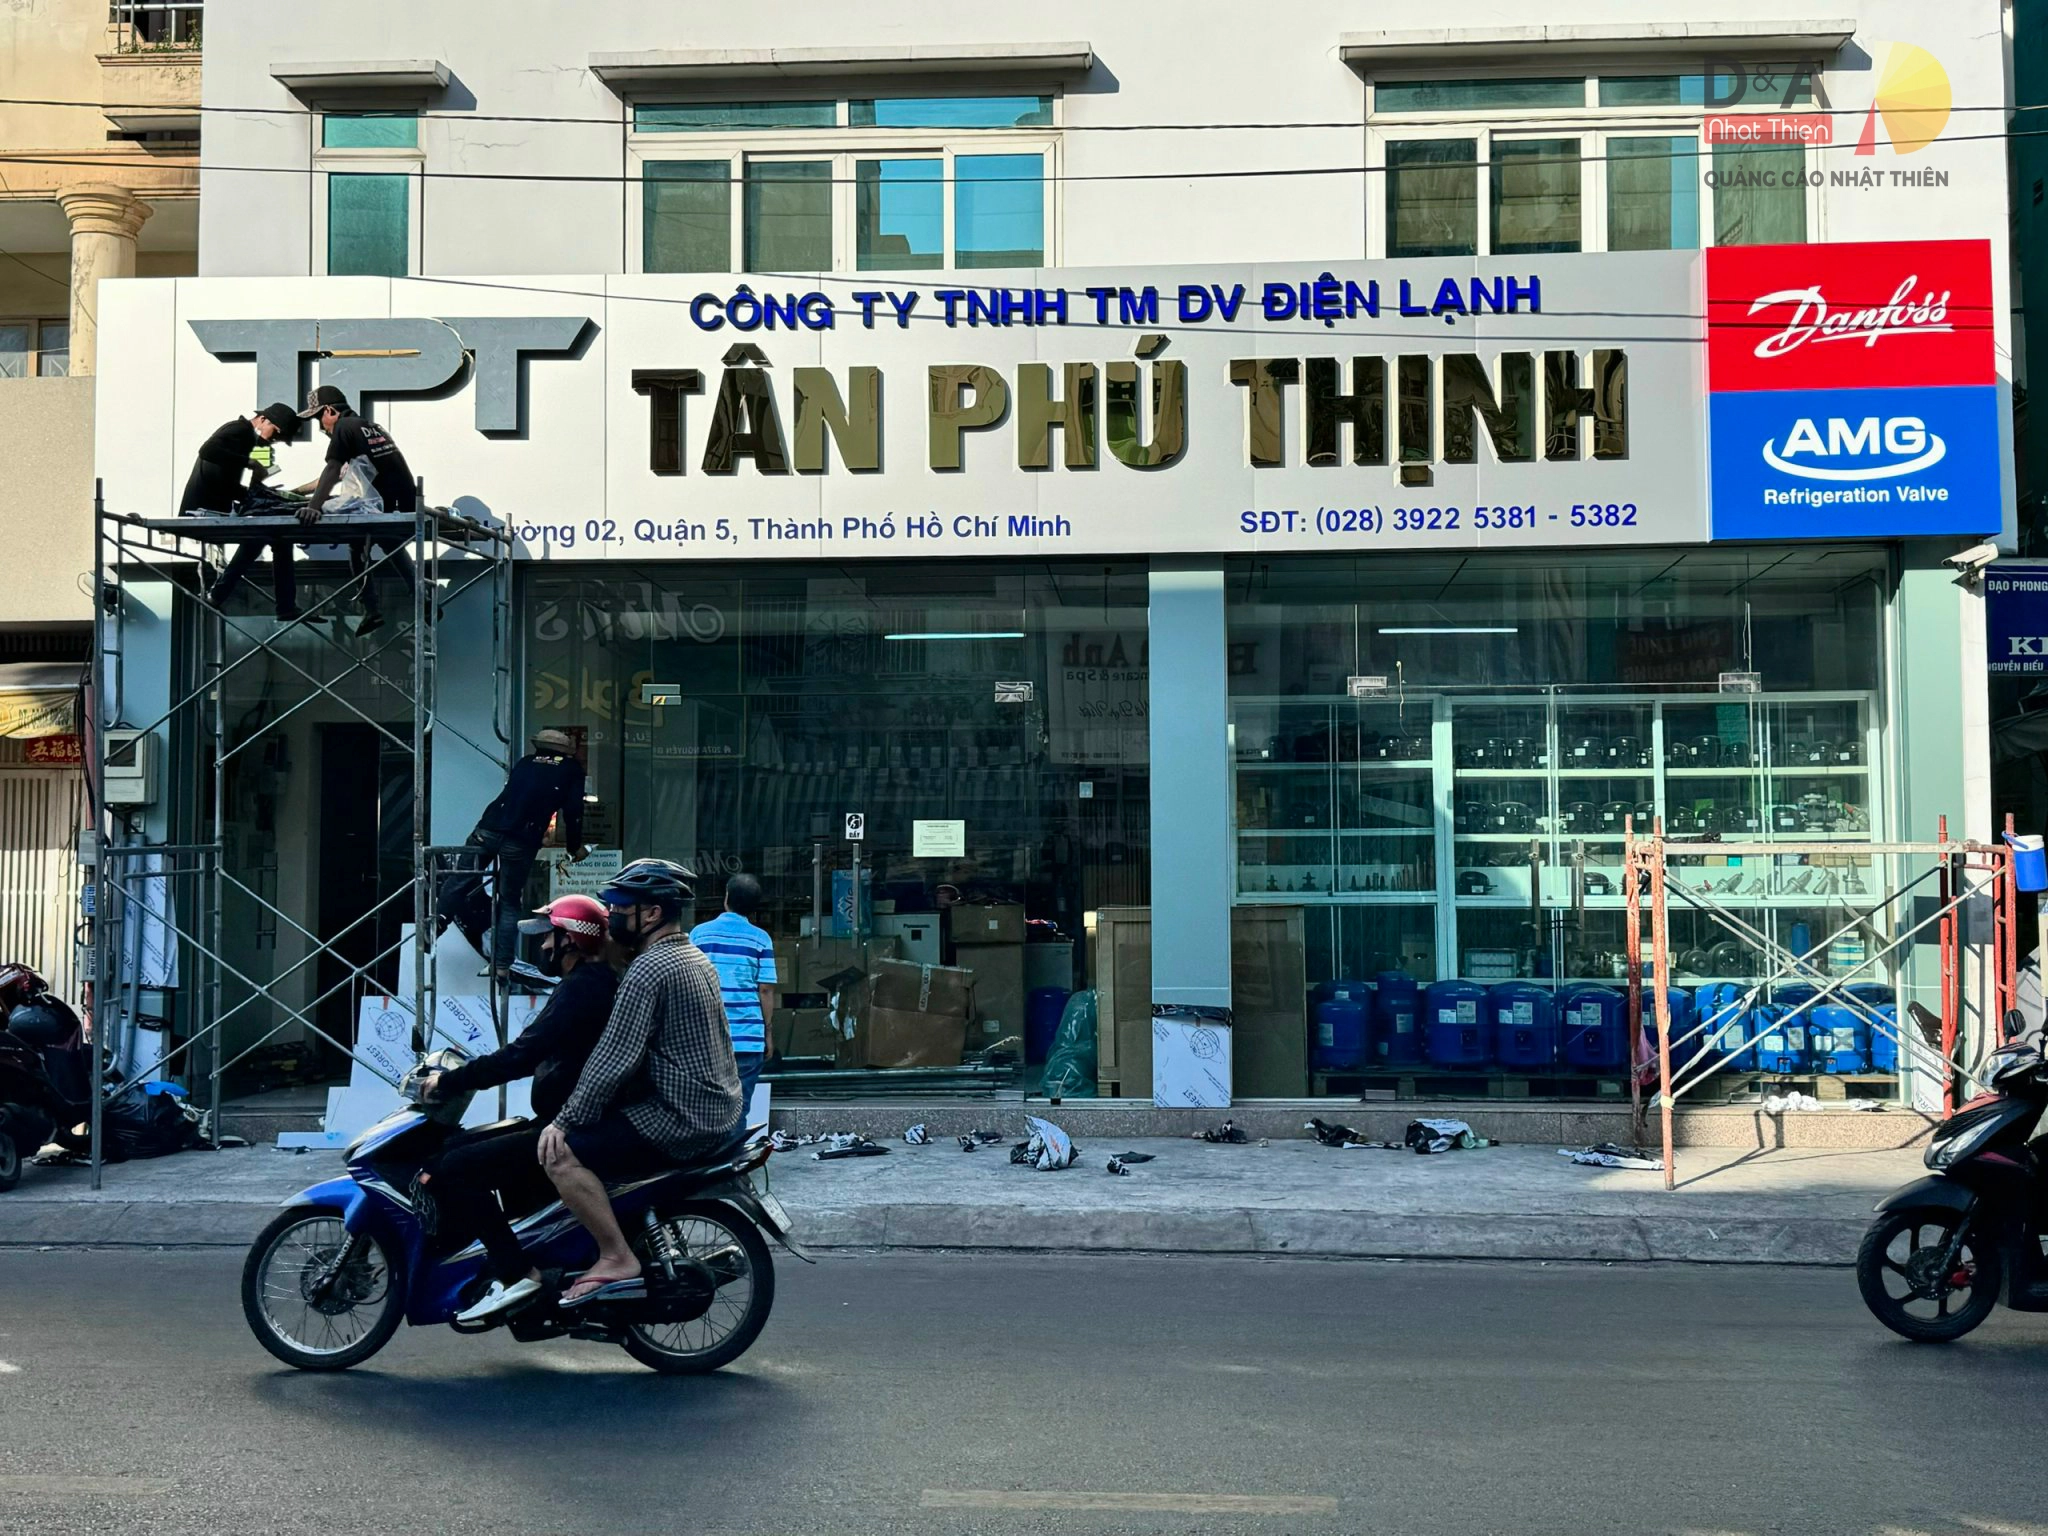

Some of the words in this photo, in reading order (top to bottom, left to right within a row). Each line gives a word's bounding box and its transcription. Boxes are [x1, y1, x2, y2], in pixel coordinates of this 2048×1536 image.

[689, 283, 835, 331] CÔNG
[852, 290, 920, 329] TY
[934, 287, 1068, 328] TNHH
[1085, 285, 1159, 325] TM
[1178, 283, 1246, 323] DV
[1261, 271, 1380, 327] ĐIỆN
[1399, 275, 1542, 325] LẠNH
[1746, 274, 1955, 359] Danfoss
[187, 316, 601, 440] TPT
[631, 342, 885, 477] TÂN
[928, 333, 1189, 474] PHÚ
[1226, 347, 1630, 488] THỊNH
[1780, 416, 1927, 458] AMG
[1763, 488, 1890, 508] Refrigeration
[1896, 486, 1949, 502] Valve
[511, 519, 575, 548] ờng
[585, 518, 624, 546] 02,
[634, 516, 706, 548] Quận
[715, 518, 738, 545] 5,
[747, 516, 833, 540] Thành
[843, 511, 896, 539] Phố
[906, 510, 943, 538] Hồ
[953, 514, 998, 538] Chí
[1008, 514, 1071, 537] Minh
[1239, 509, 1308, 533] SĐT:
[1315, 505, 1383, 535] (028)
[1392, 507, 1460, 530] 3922
[1473, 505, 1537, 528] 5381
[1570, 503, 1638, 527] 5382
[1988, 580, 2010, 594] ĐẠO
[2012, 580, 2048, 592] PHONG
